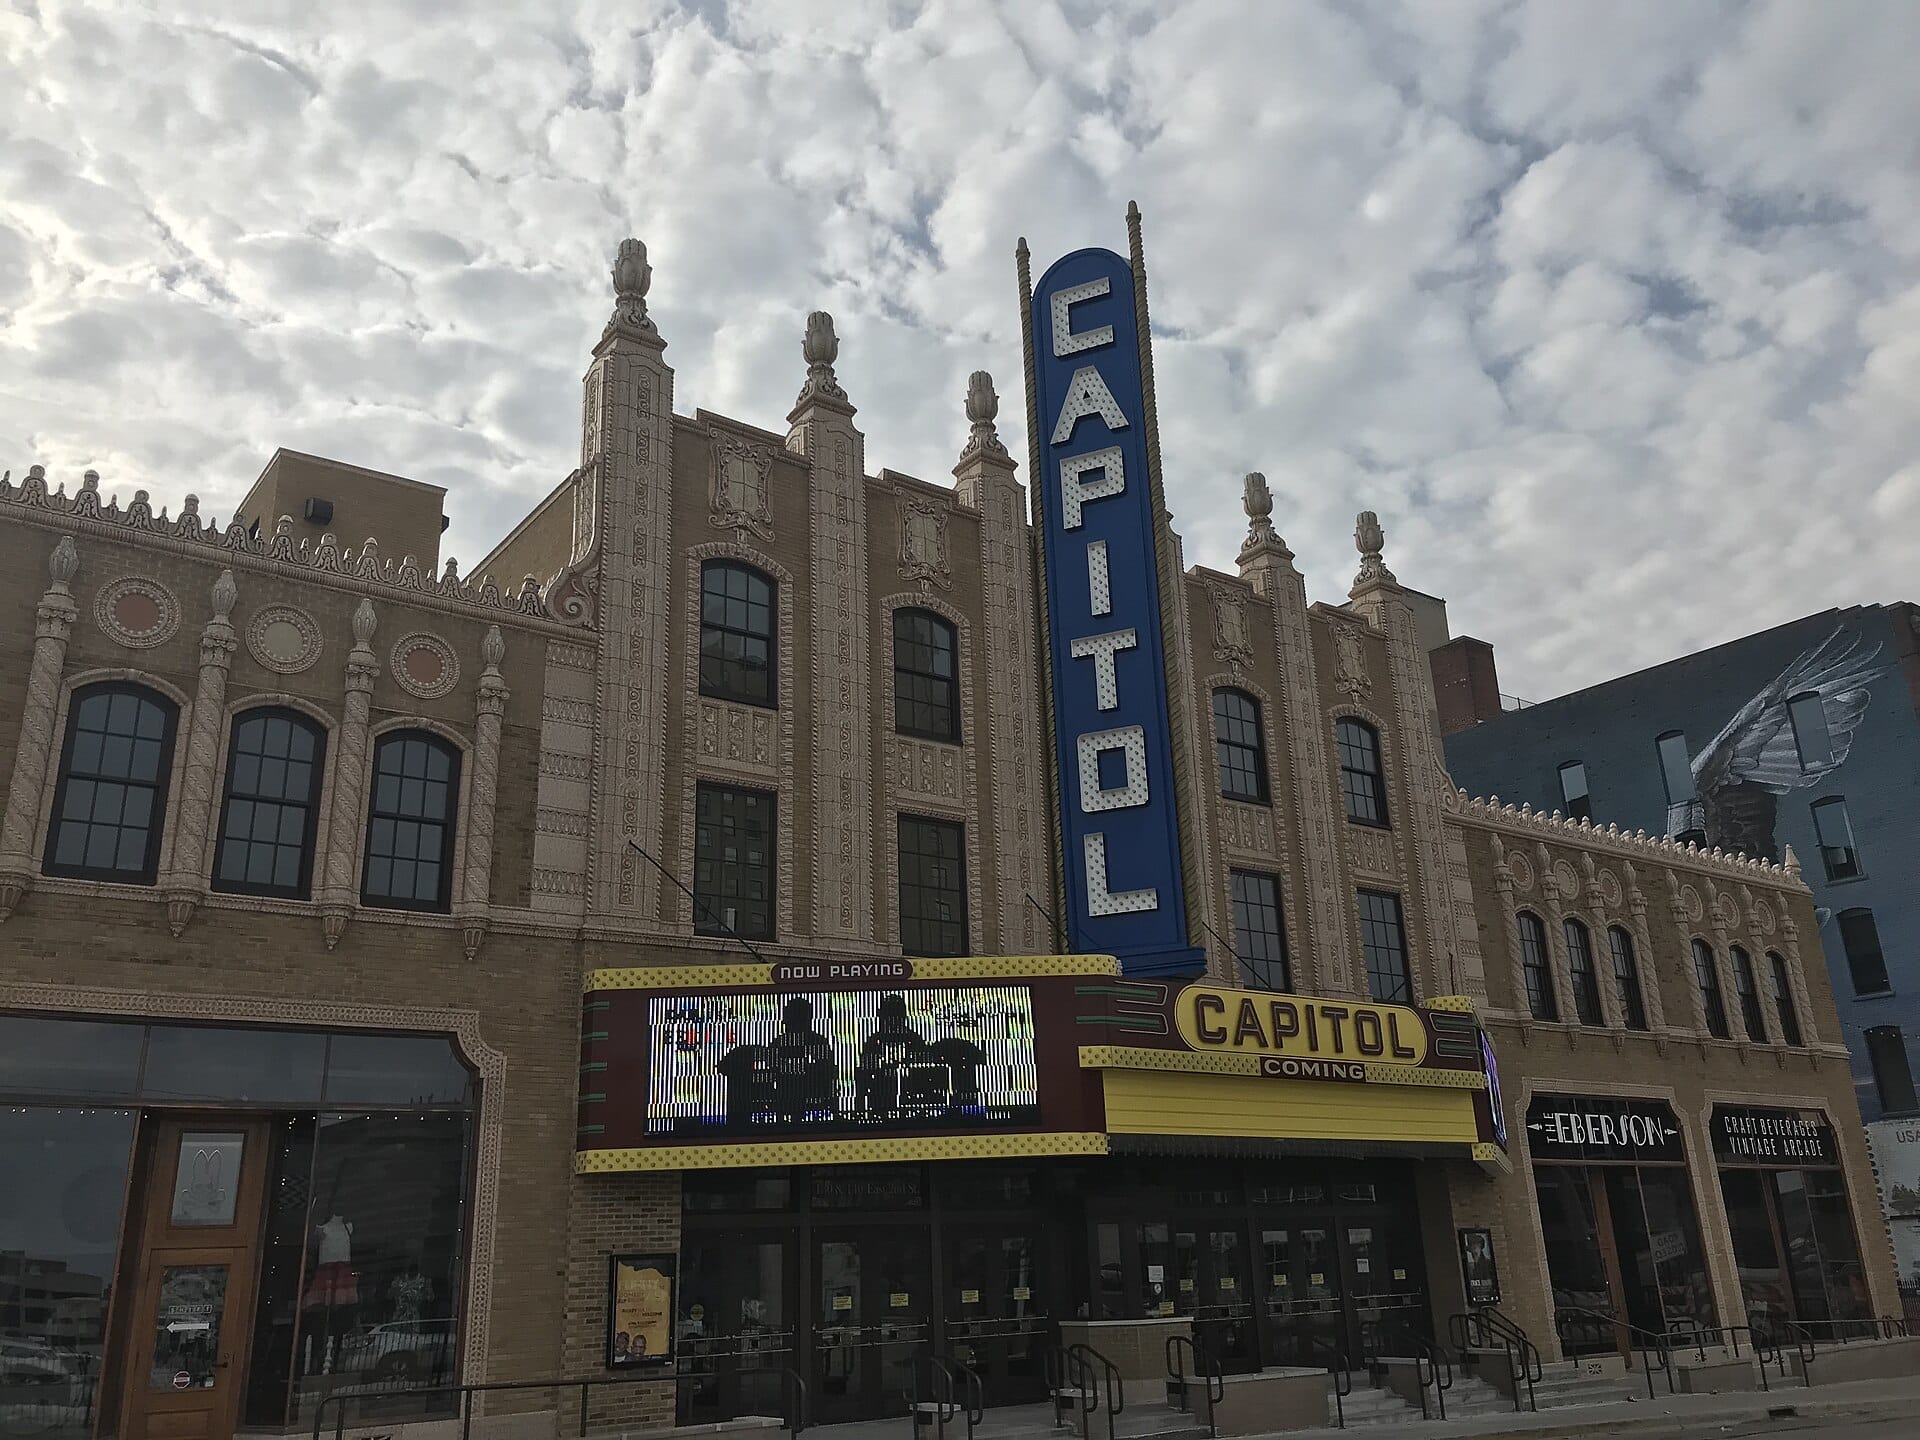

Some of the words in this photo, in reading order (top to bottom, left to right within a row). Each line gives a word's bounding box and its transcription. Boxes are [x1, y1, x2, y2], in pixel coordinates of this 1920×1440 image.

[1050, 276, 1158, 917] CAPITOL
[780, 966, 820, 979] NOW
[830, 963, 904, 977] PLAYING
[1195, 993, 1416, 1059] CAPITOL
[1263, 1059, 1364, 1080] COMING
[1542, 1112, 1557, 1144] THE
[1554, 1112, 1665, 1146] EBERSON
[1724, 1116, 1758, 1135] CRAFT
[1759, 1117, 1818, 1137] BEVERAGES
[1729, 1136, 1778, 1156] VINTAGE
[1783, 1139, 1824, 1157] ARCADE
